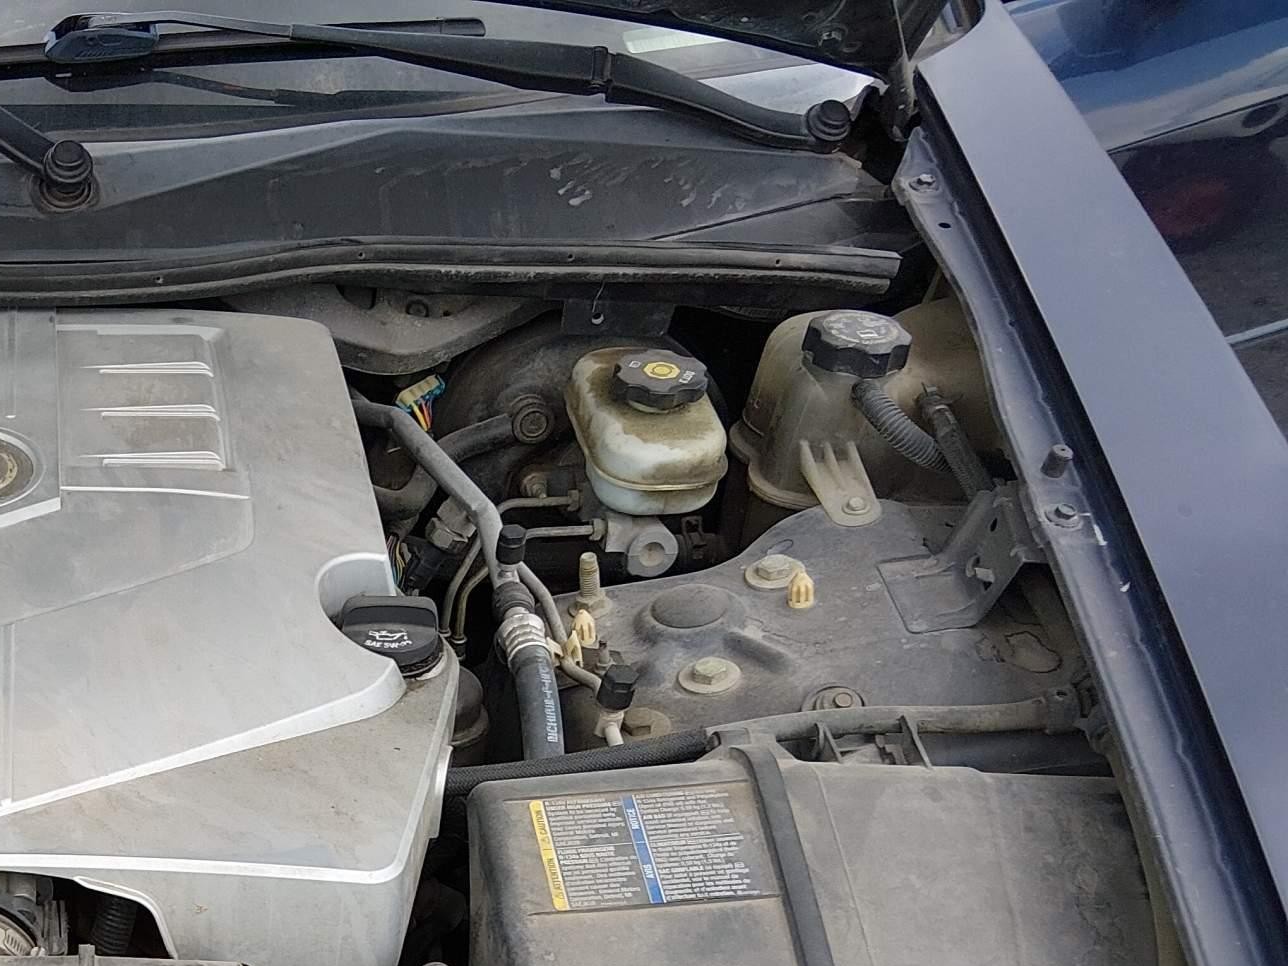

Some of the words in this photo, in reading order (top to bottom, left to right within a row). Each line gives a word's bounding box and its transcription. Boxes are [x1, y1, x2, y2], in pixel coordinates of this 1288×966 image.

[537, 810, 549, 836] CAUTION
[626, 808, 640, 830] NOTICE
[548, 858, 562, 892] ATTENTION
[642, 864, 654, 879] AVIS
